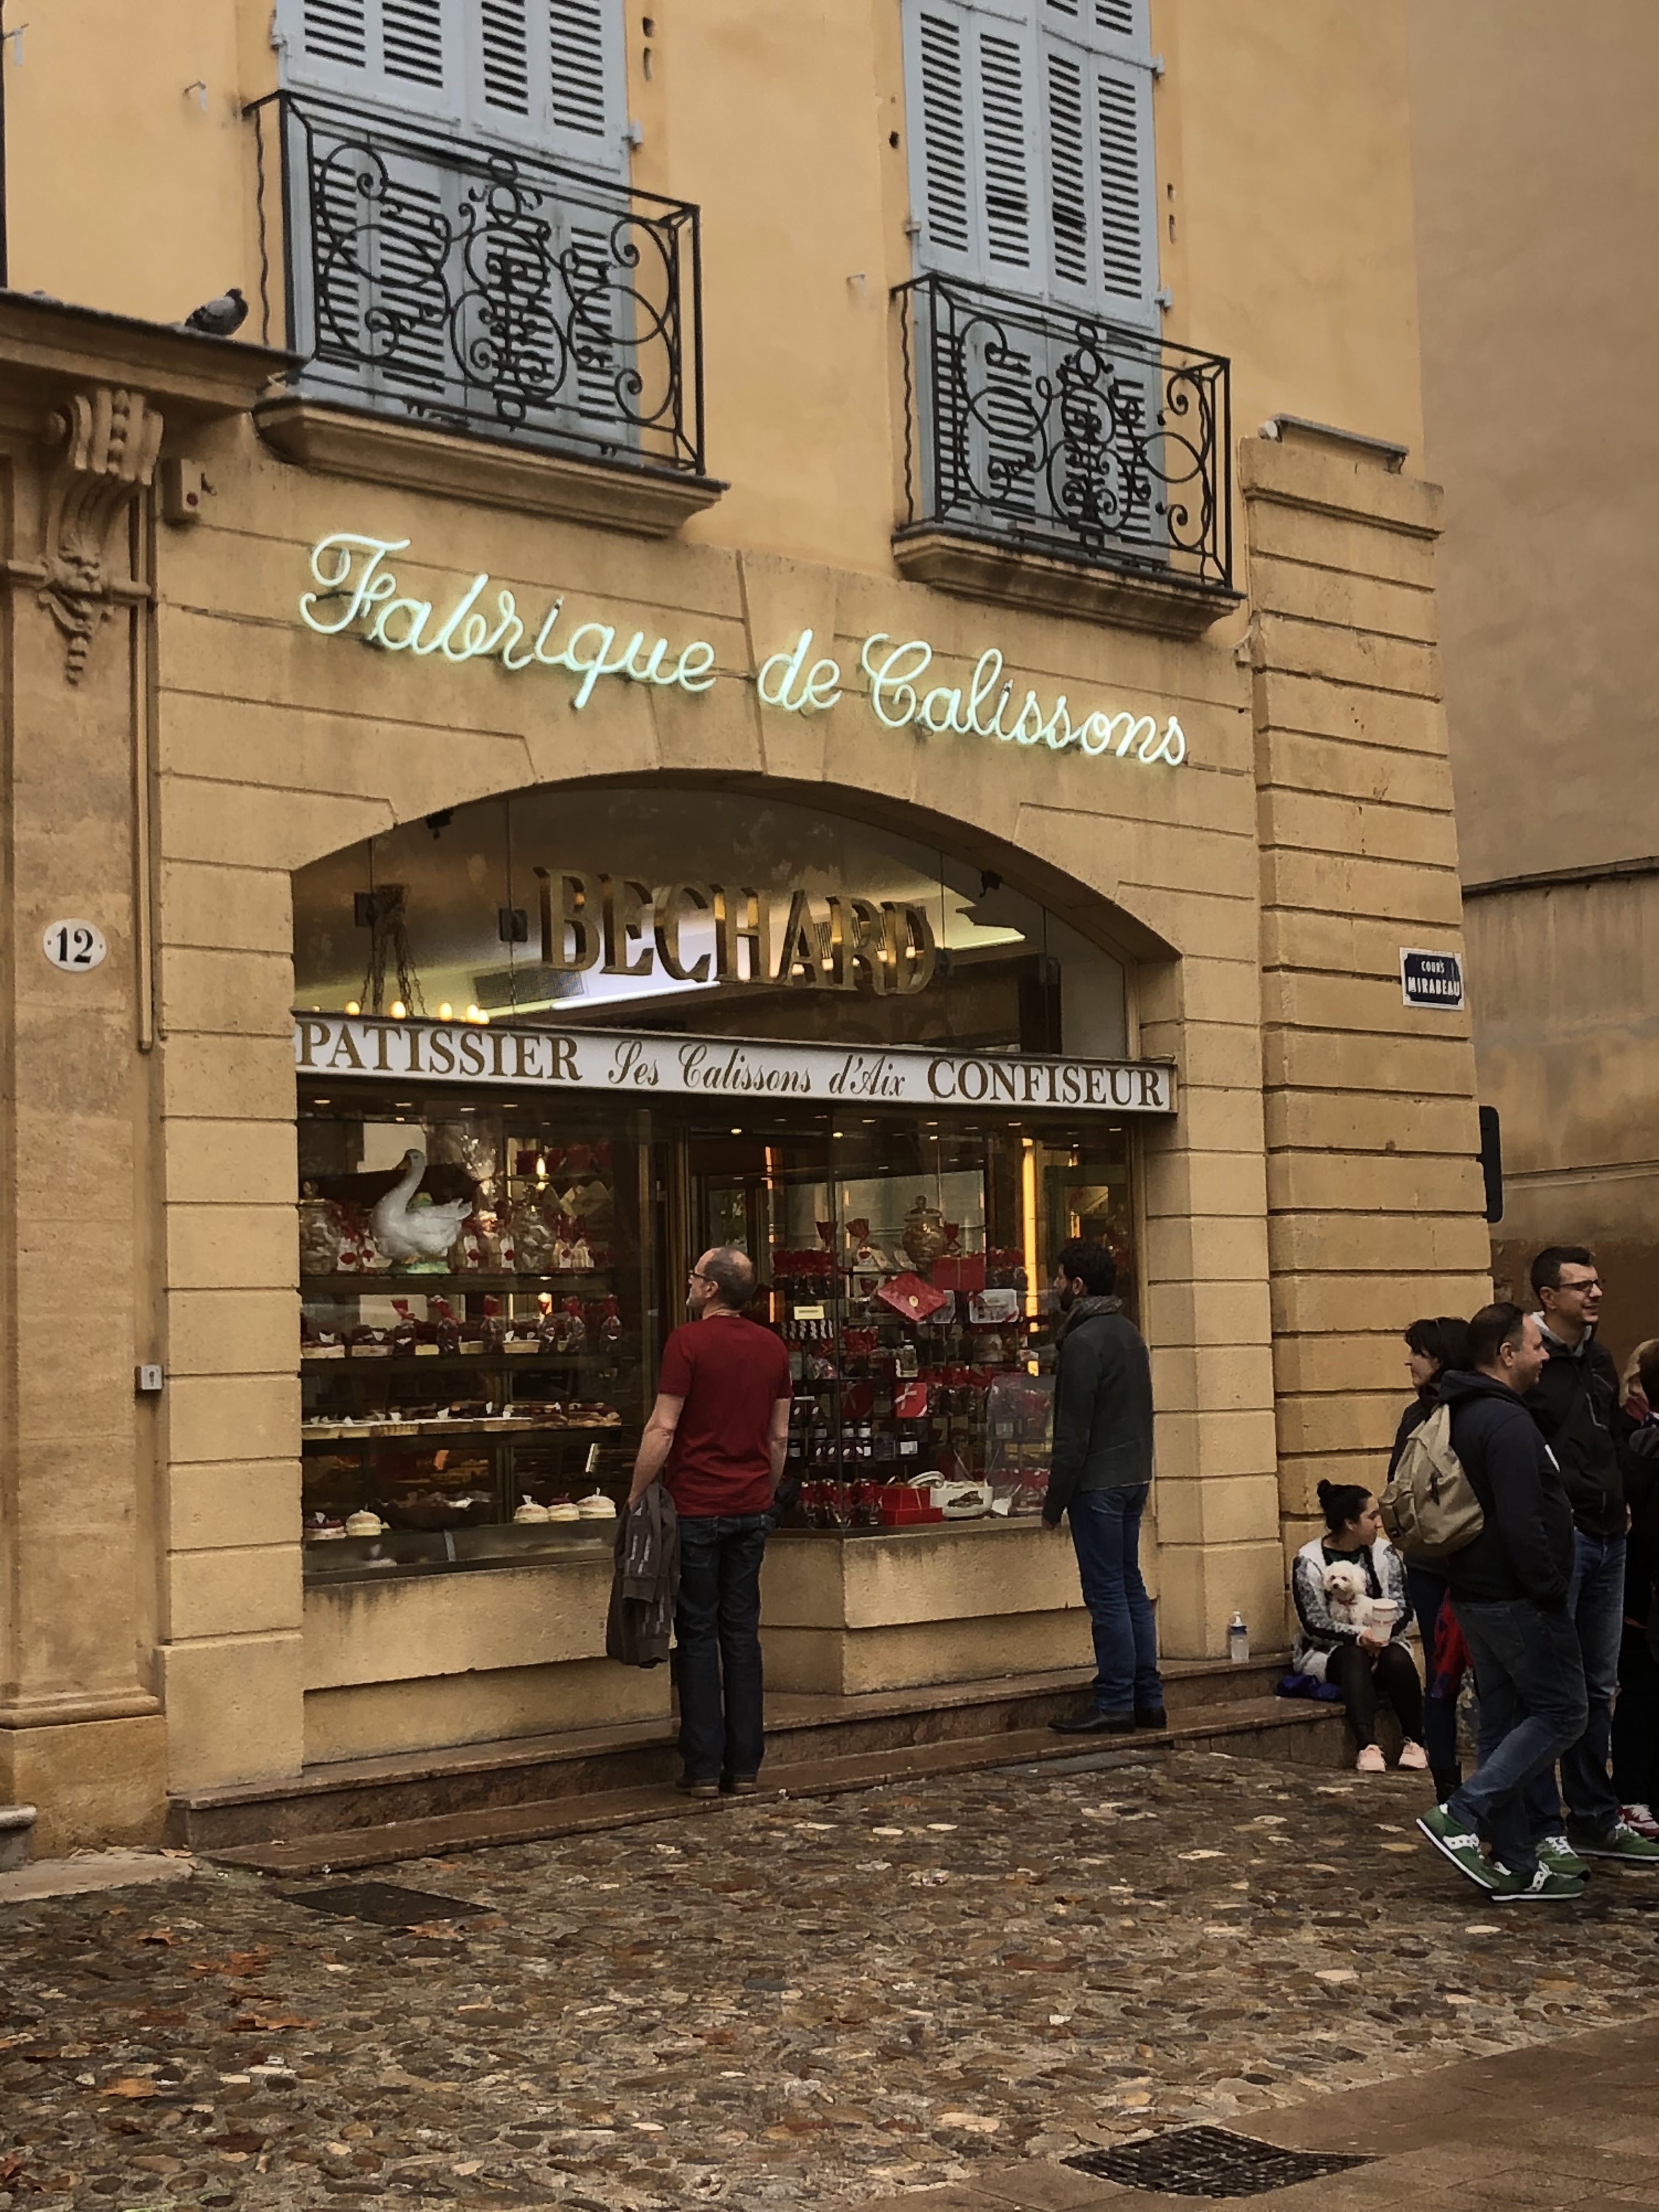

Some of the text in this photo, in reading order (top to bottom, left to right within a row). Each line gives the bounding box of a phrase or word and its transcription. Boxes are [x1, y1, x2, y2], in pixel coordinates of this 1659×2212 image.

[300, 533, 1188, 766] Fabrique de Calissons
[57, 927, 93, 964] 12
[533, 866, 936, 996] BECHARD
[1408, 976, 1460, 997] MIRABEAU
[1421, 960, 1445, 974] COURS
[296, 1020, 583, 1081] PATISSIER
[678, 1043, 811, 1093] Calissons
[828, 1054, 906, 1097] d'Aix
[927, 1058, 1164, 1107] CONFISEUR
